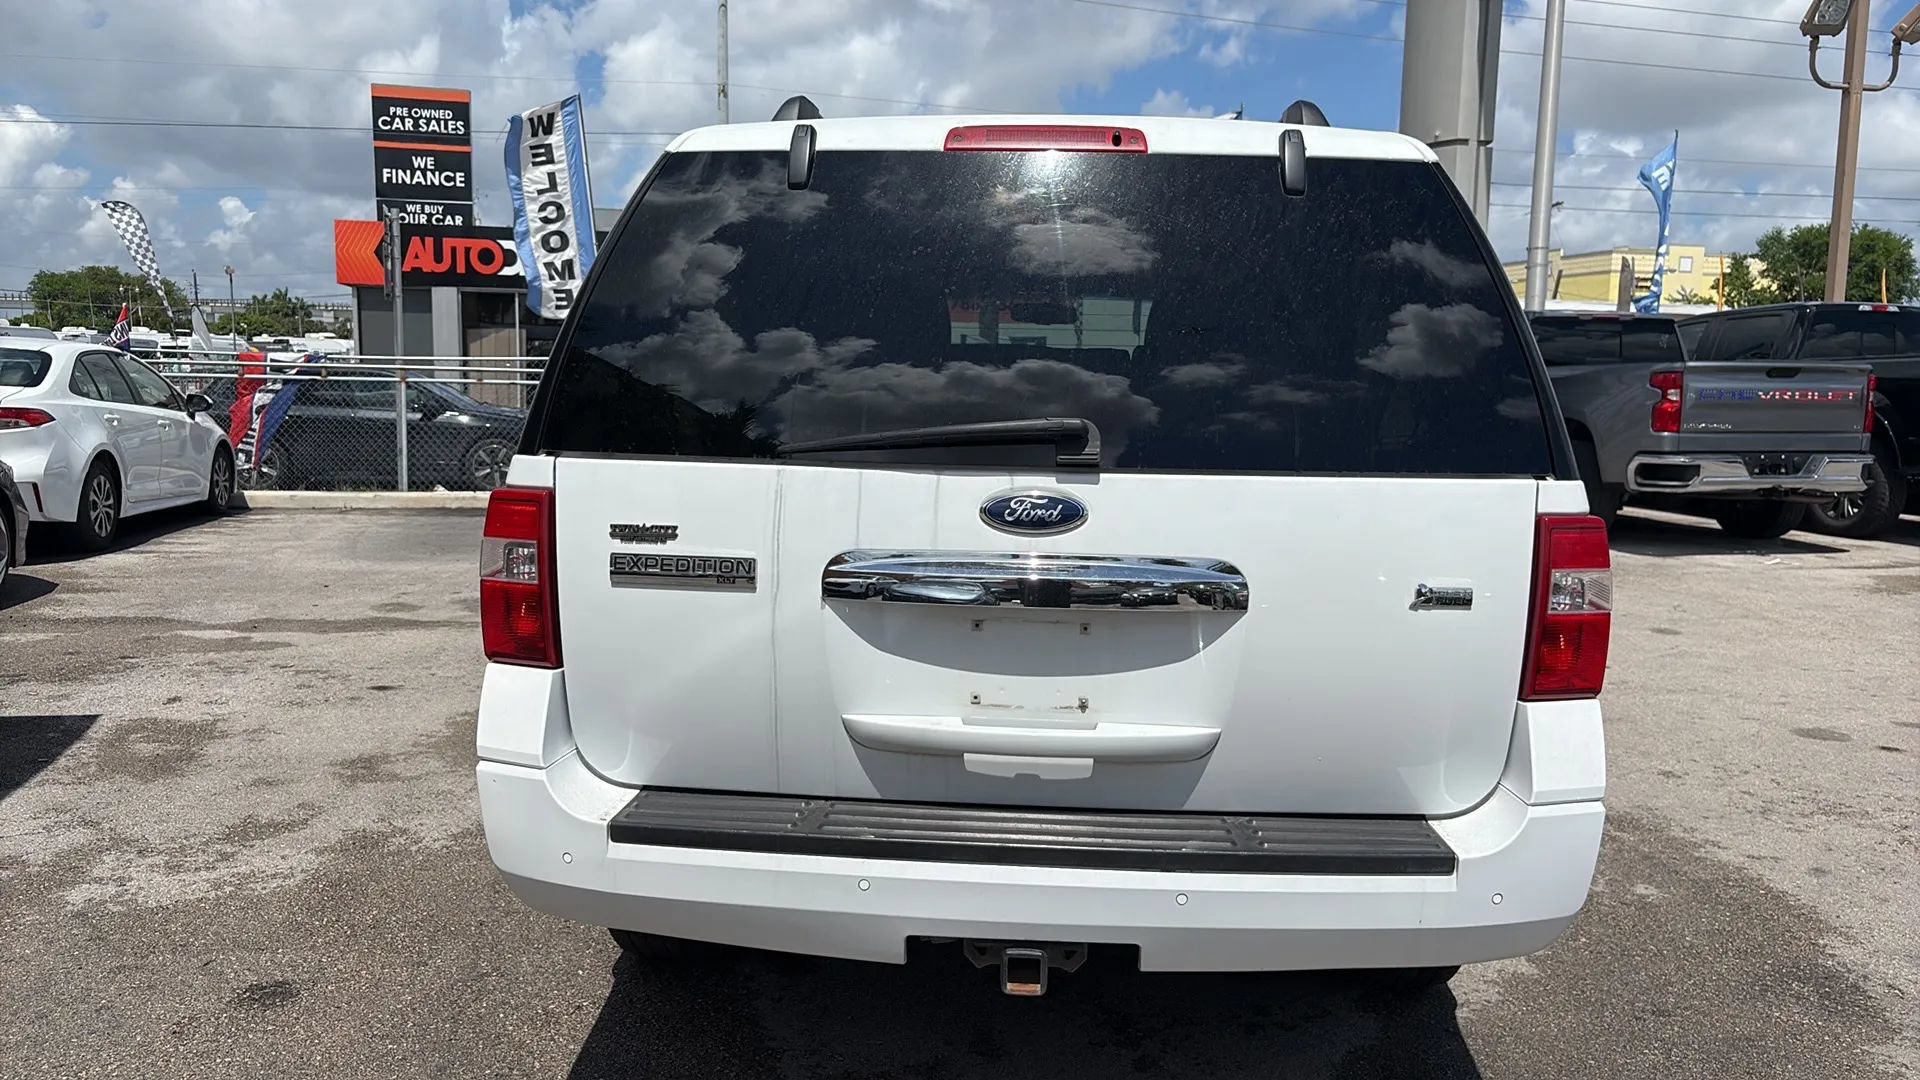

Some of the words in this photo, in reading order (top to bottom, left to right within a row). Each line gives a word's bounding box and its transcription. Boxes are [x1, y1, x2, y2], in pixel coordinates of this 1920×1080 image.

[389, 106, 409, 116] PRE
[411, 108, 453, 119] OWNED
[378, 116, 414, 131] CAR
[418, 118, 465, 135] SALES
[411, 156, 435, 169] WE
[382, 168, 465, 187] FINANCE
[405, 203, 422, 214] WE
[424, 205, 444, 214] BUY
[397, 212, 428, 225] OUR
[431, 214, 464, 226] CAR
[1003, 496, 1063, 521] Ford
[612, 555, 755, 576] EXPEDITION
[717, 576, 736, 584] XLT
